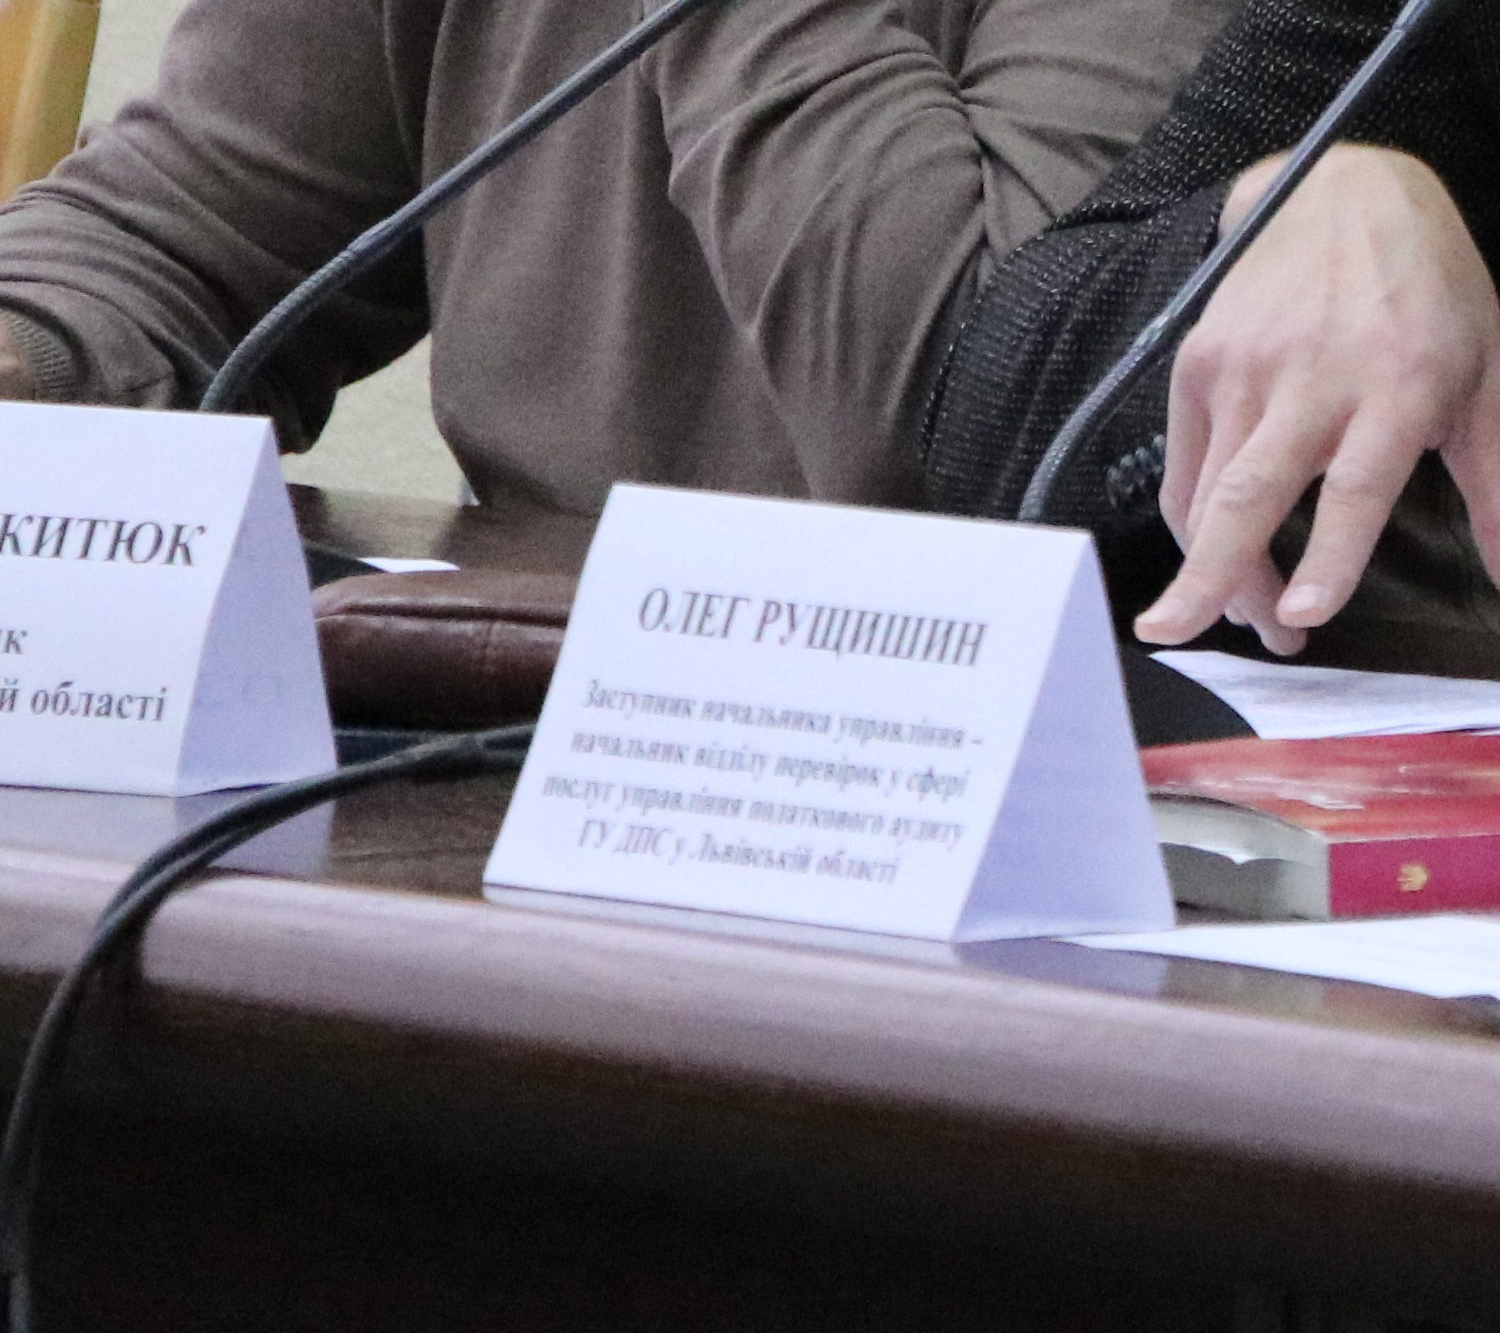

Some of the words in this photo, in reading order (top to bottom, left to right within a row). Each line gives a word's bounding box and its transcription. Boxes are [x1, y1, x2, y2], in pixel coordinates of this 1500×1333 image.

[636, 586, 752, 640] ОЛЕГ
[754, 599, 987, 666] РУЩИШИН
[30, 680, 169, 722] області
[584, 678, 696, 721] Заступник
[700, 700, 832, 735] начальника
[833, 713, 968, 749] управління
[569, 730, 690, 765] начальник
[693, 740, 770, 783] відділу
[774, 754, 885, 792] перевірок
[905, 764, 971, 804] сфері
[542, 774, 614, 810] послуг
[614, 786, 745, 817] управління
[747, 799, 885, 834] податкового
[888, 816, 967, 852] аудиту
[578, 819, 612, 850] ГУ
[612, 822, 674, 859] ДПС
[687, 832, 813, 876] Львівській
[815, 850, 901, 885] області
